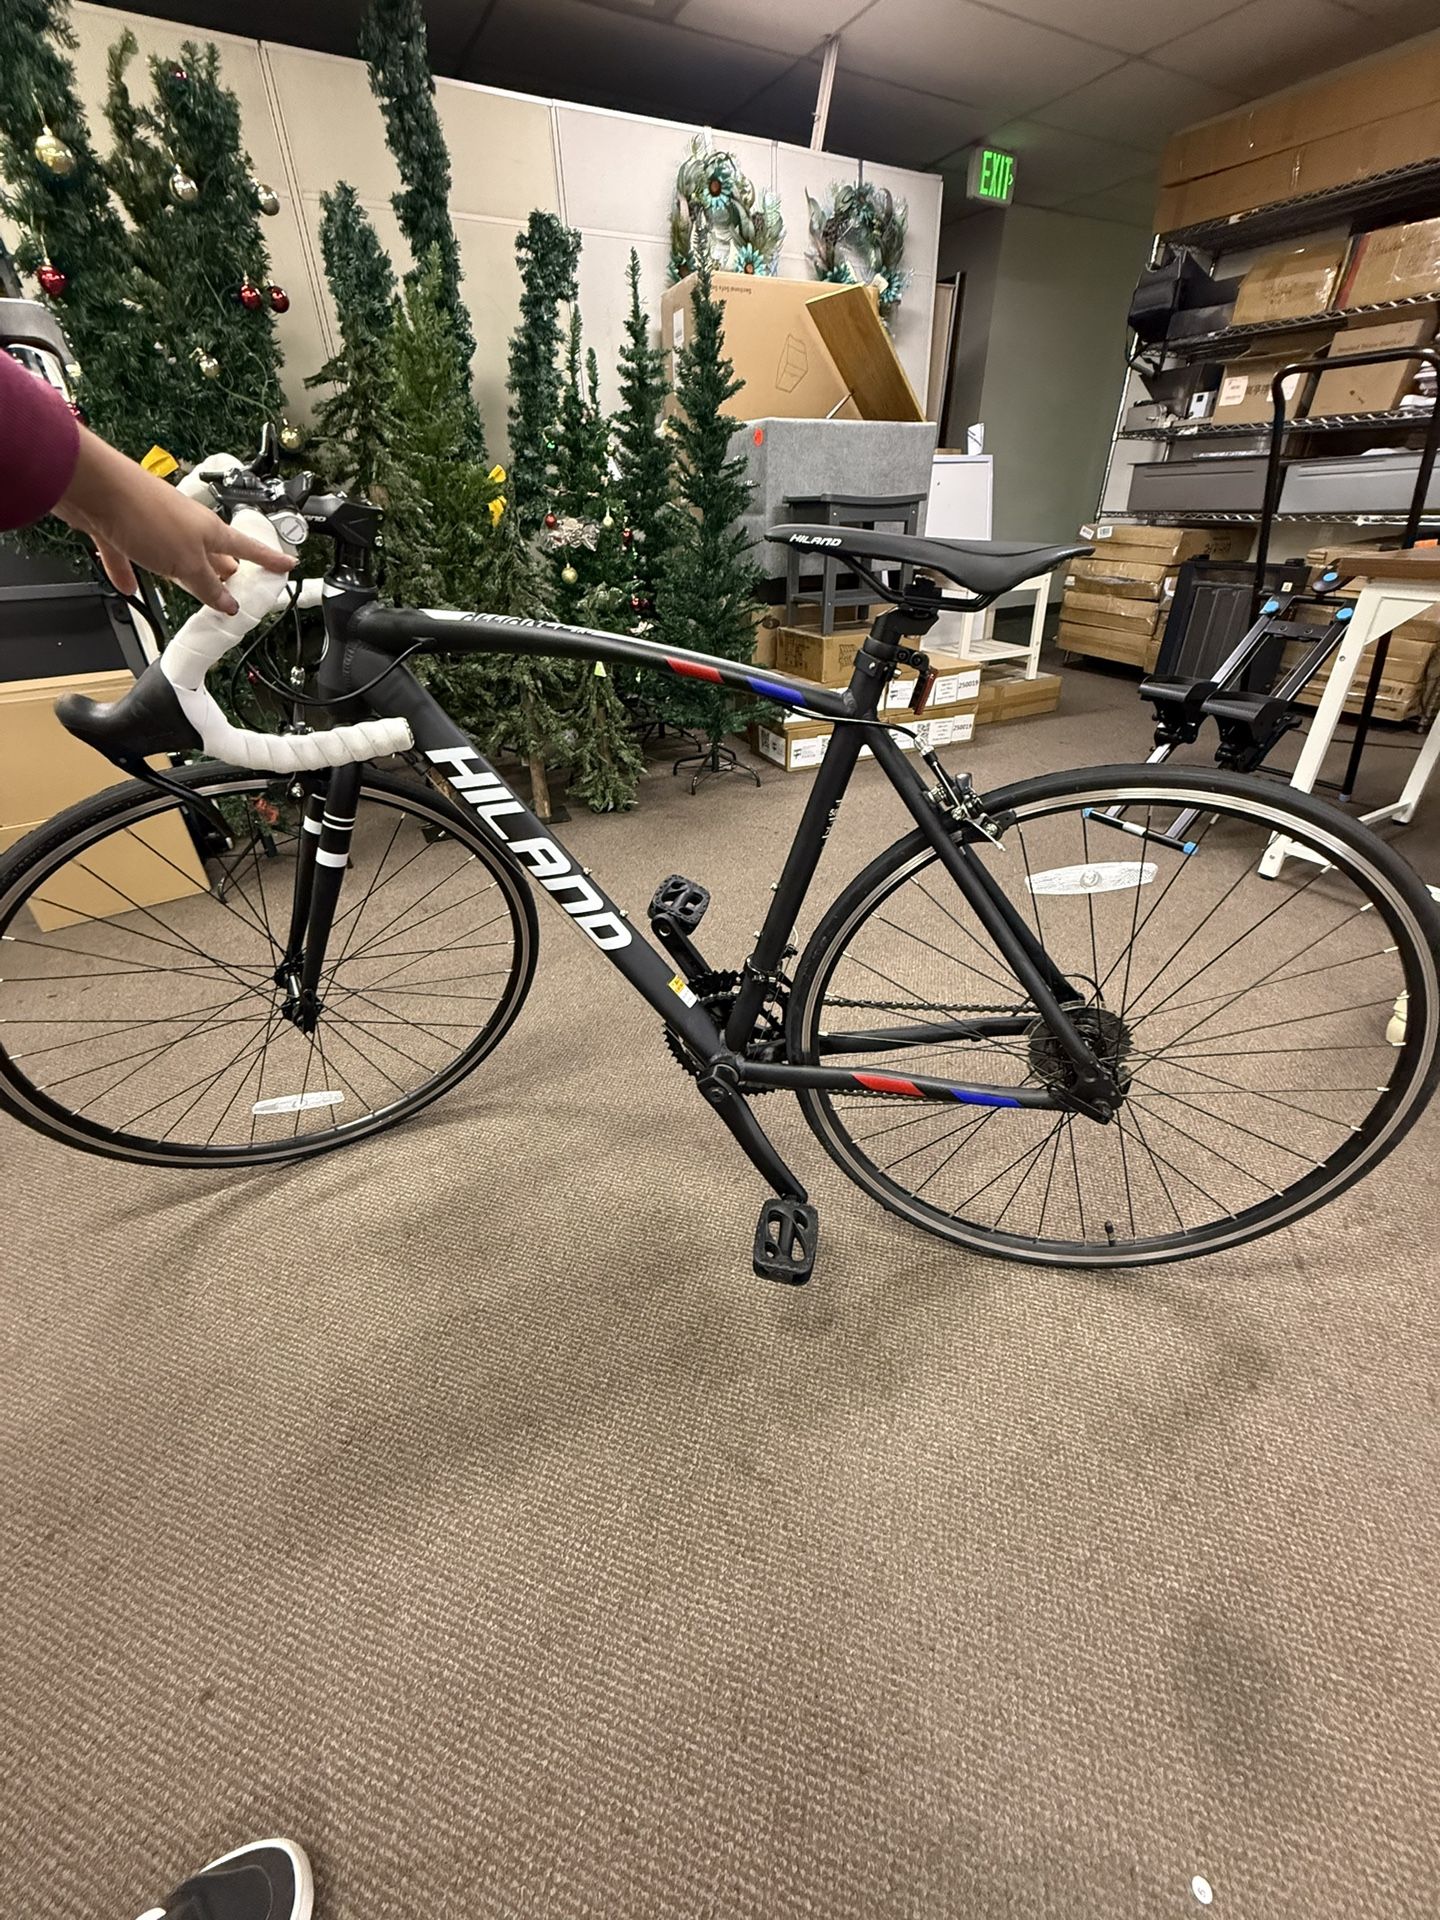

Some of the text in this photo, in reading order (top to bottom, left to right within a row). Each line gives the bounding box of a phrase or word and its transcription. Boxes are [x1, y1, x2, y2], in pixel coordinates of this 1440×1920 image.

[979, 150, 1013, 200] EXIT
[789, 533, 842, 547] HILAND
[424, 746, 633, 951] HILAND
